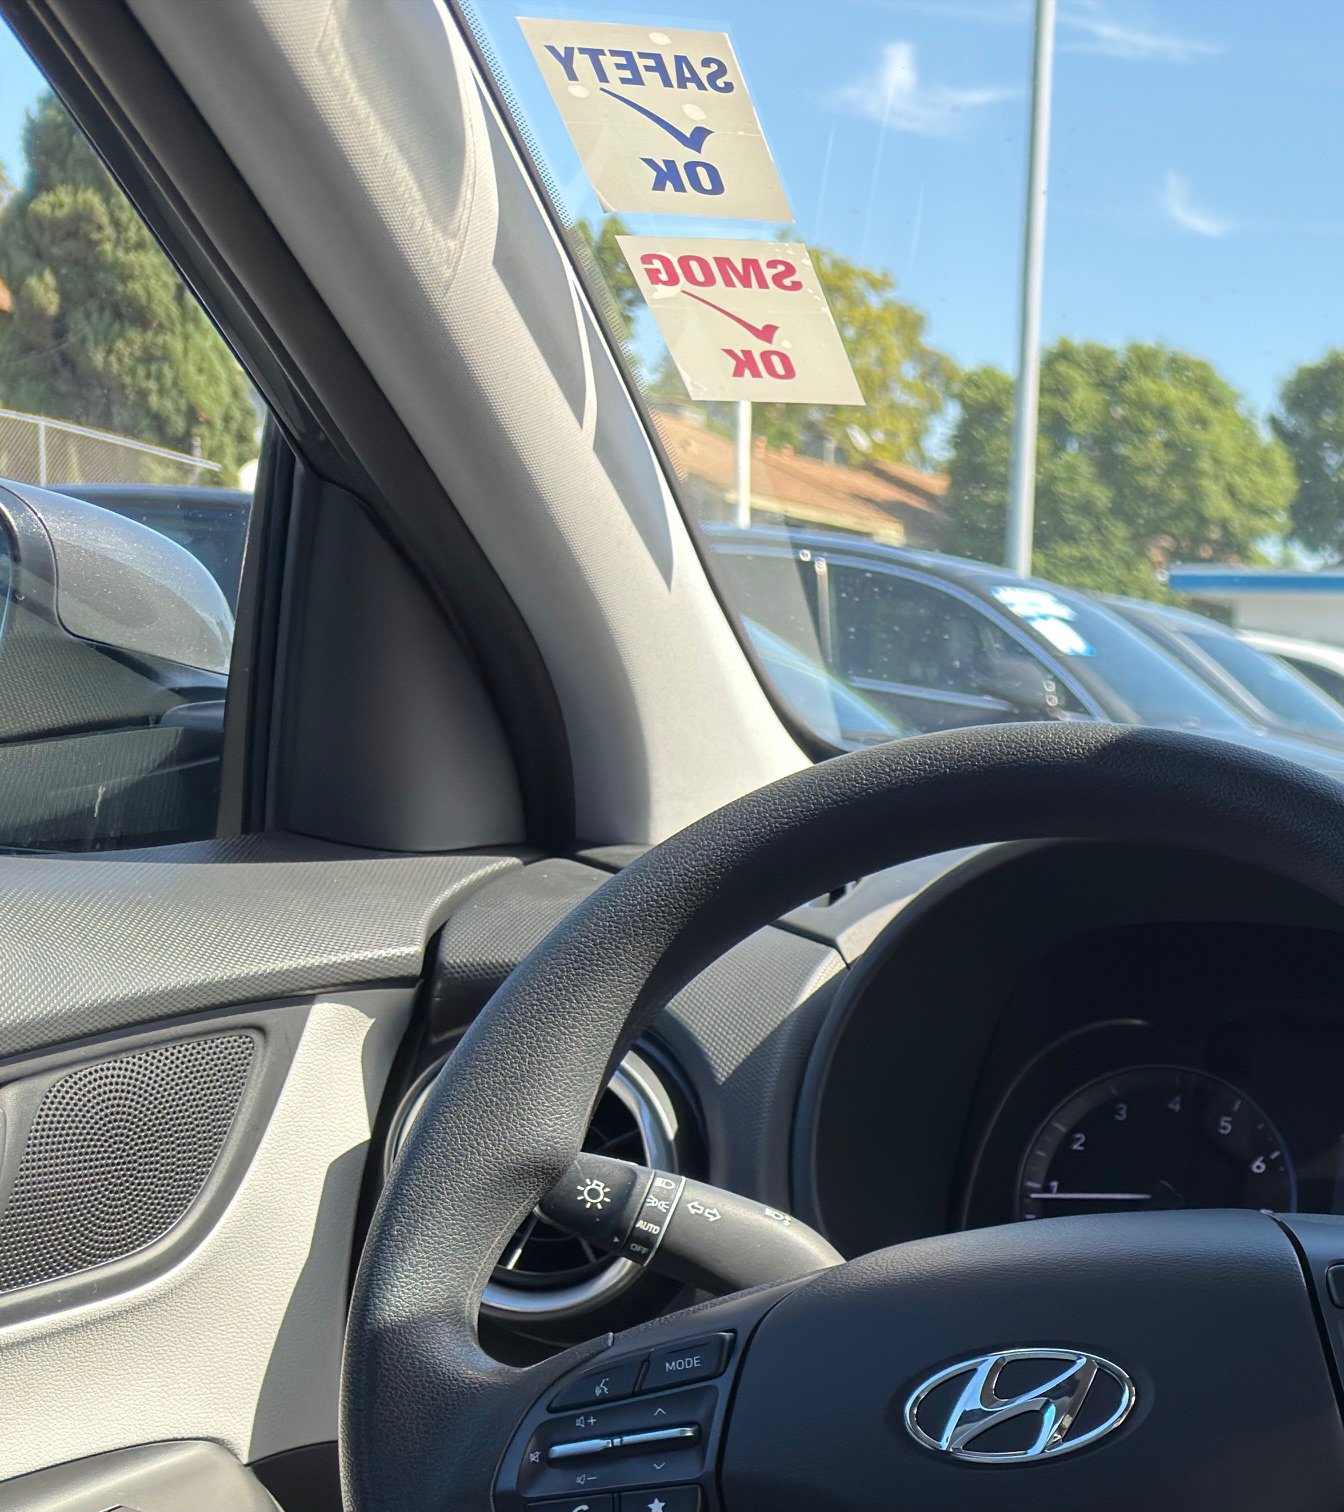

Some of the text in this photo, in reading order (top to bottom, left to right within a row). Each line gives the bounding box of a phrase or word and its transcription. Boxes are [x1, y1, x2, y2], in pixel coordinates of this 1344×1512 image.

[1115, 1103, 1127, 1121] 3
[1168, 1095, 1181, 1113] 4
[1217, 1116, 1232, 1135] 5
[1071, 1133, 1086, 1151] 2
[1251, 1156, 1266, 1174] 6
[1050, 1181, 1059, 1195] 1
[635, 1219, 660, 1235] AUTO
[629, 1243, 649, 1255] OFF
[665, 1355, 701, 1372] MODE
